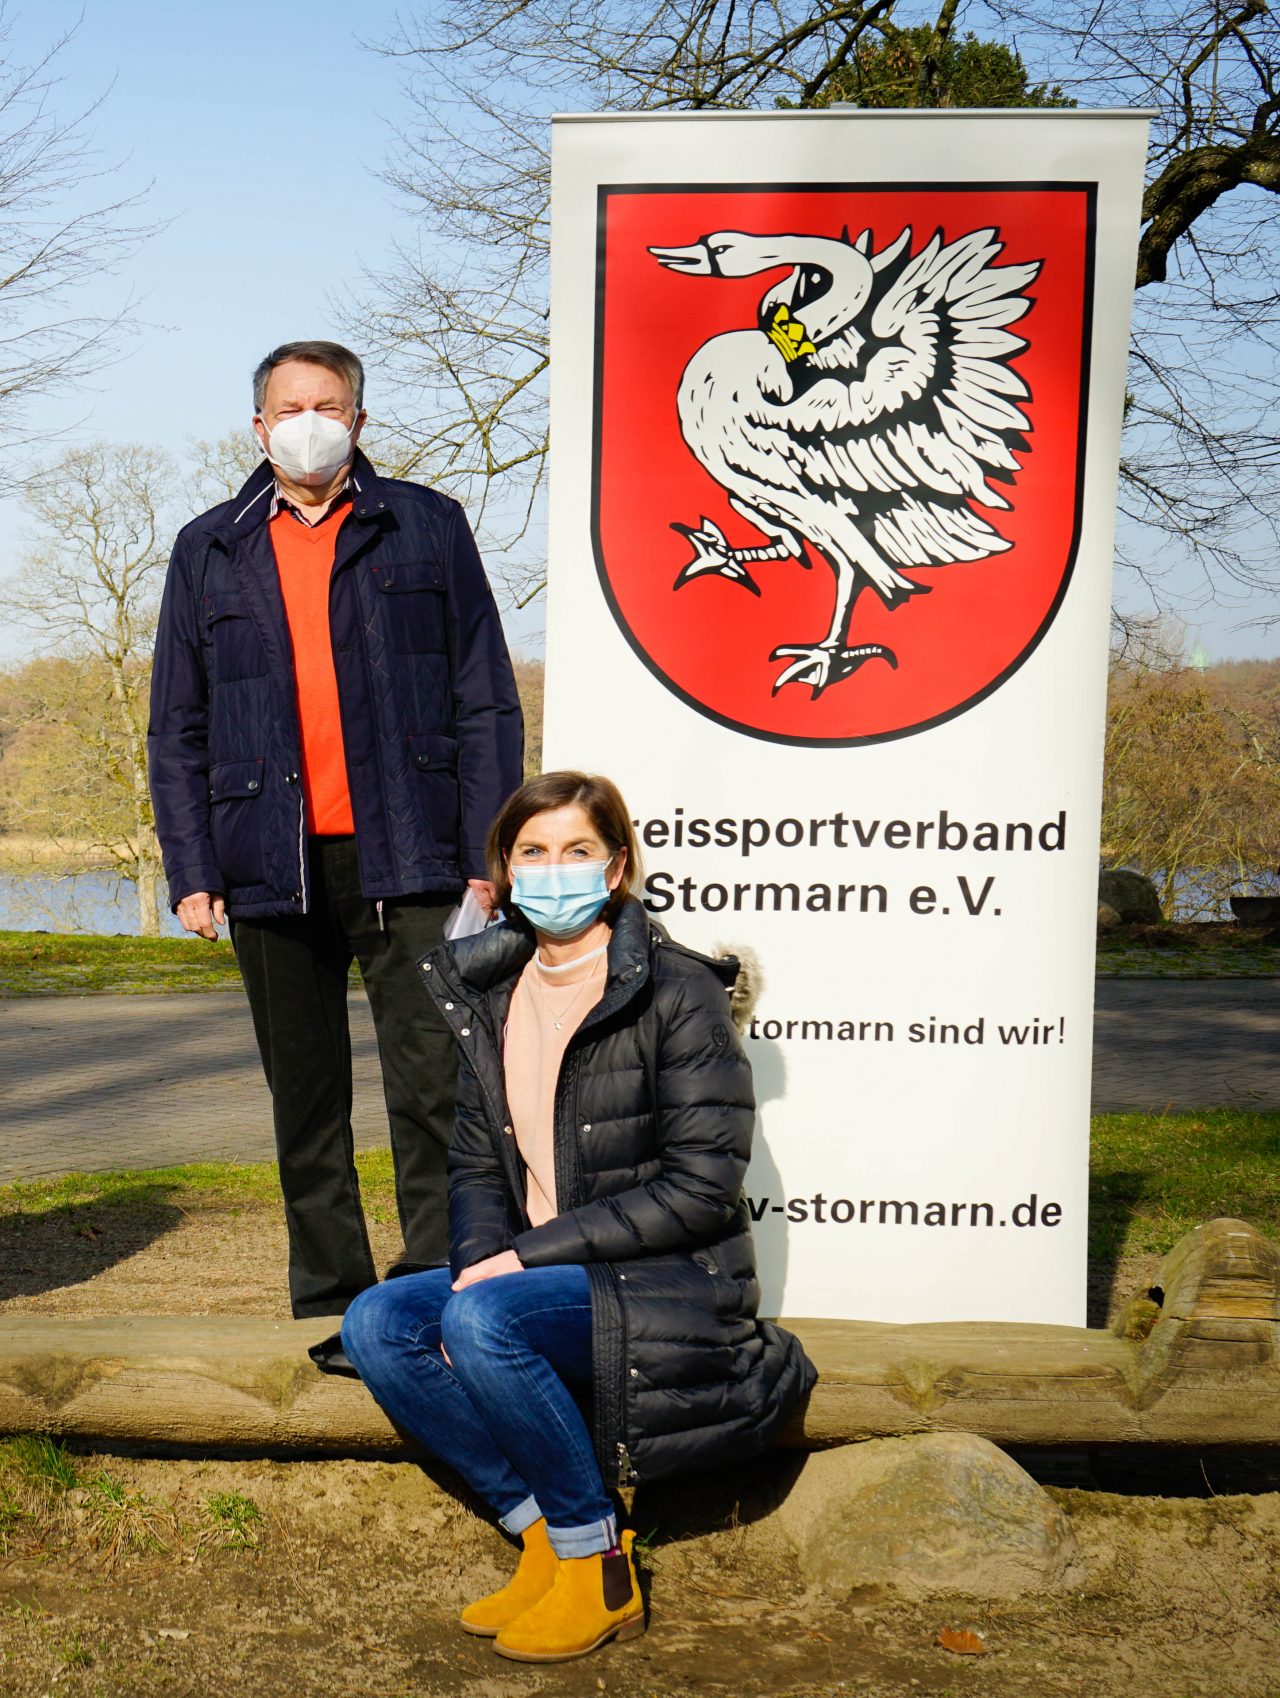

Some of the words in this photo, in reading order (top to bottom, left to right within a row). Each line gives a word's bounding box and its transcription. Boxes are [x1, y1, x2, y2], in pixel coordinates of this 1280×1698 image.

[632, 807, 1067, 857] eissportverband
[642, 871, 888, 915] Stormarn
[908, 875, 1003, 917] e.V.
[749, 1016, 894, 1042] tormarn
[907, 1016, 985, 1045] sind
[997, 1016, 1066, 1046] wir!
[746, 1193, 1063, 1228] v-stormarn.de
